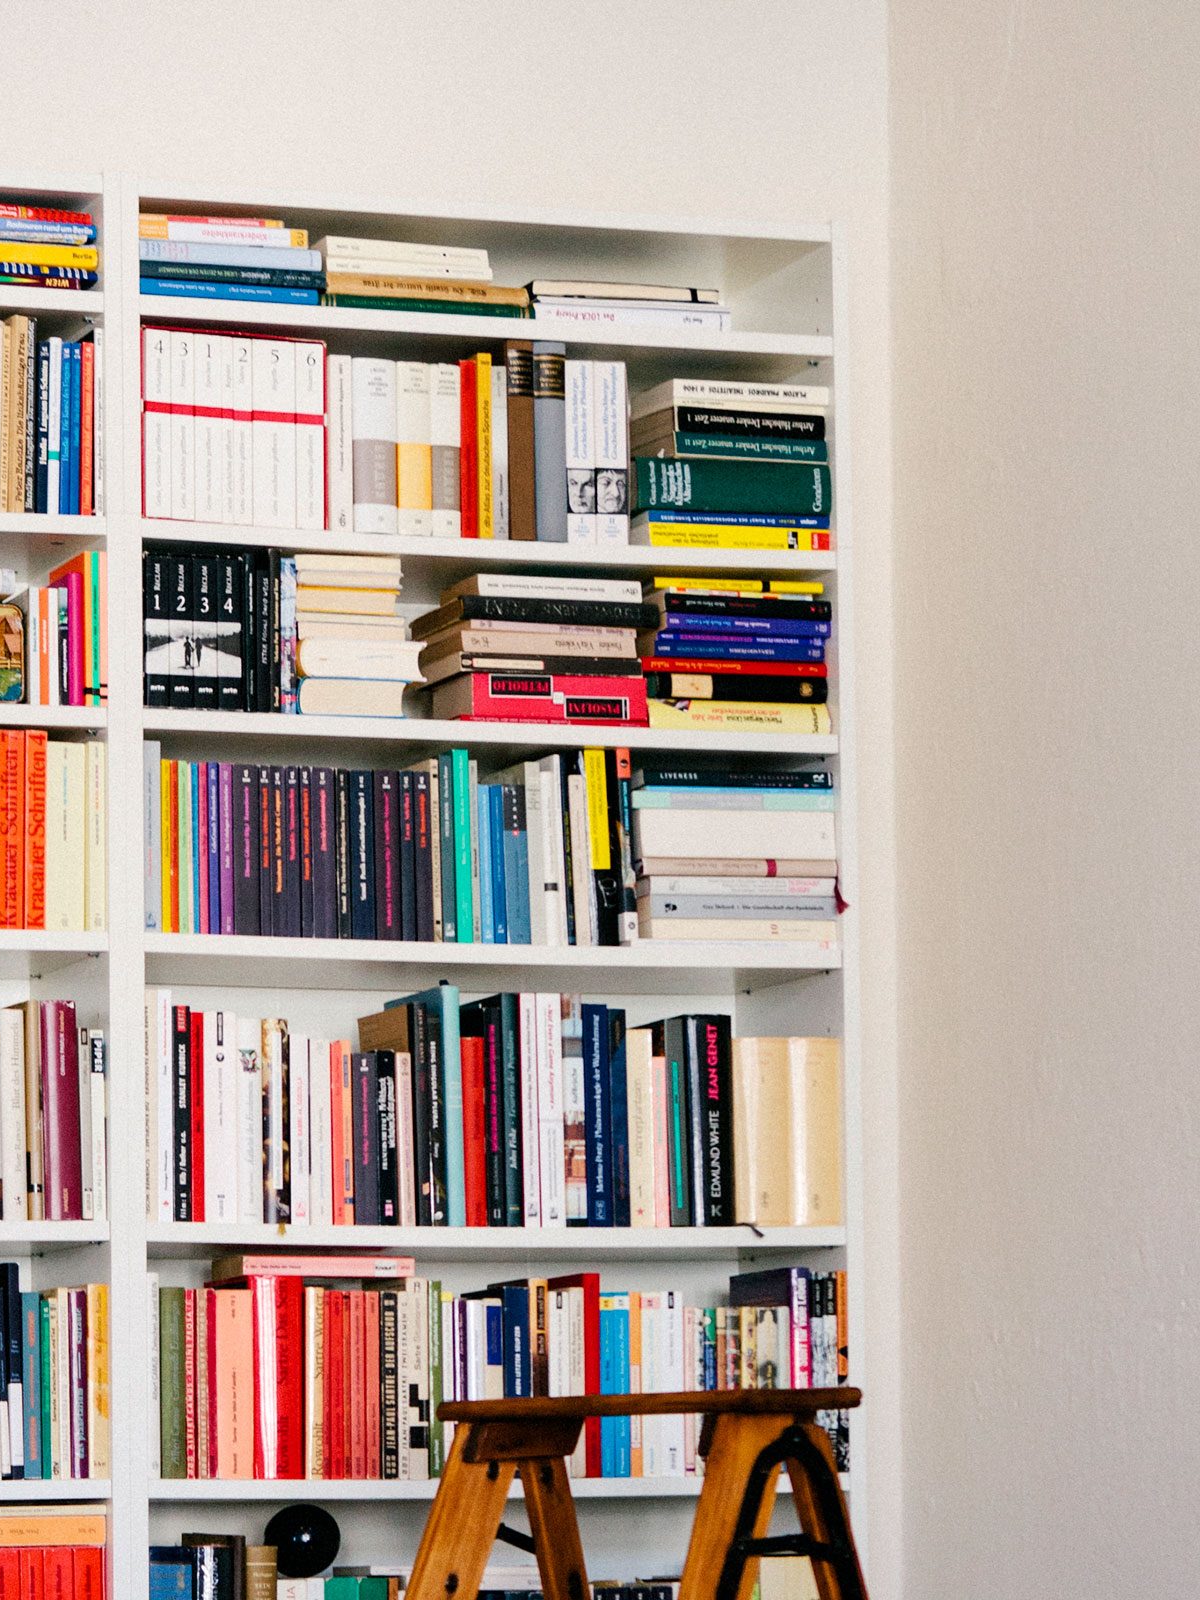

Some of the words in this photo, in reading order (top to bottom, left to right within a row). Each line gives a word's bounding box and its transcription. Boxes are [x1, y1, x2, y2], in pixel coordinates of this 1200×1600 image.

[47, 279, 70, 288] WIEN
[154, 340, 163, 354] 4
[180, 342, 188, 356] 3
[238, 348, 248, 362] 2
[270, 349, 280, 363] 5
[306, 352, 316, 366] 6
[695, 414, 709, 424] Zeit
[736, 418, 760, 428] Denker
[792, 422, 814, 432] Arthur
[692, 440, 707, 449] Zeit
[736, 442, 760, 452] Denker
[792, 446, 815, 455] Arthur
[812, 468, 822, 512] Gondrom
[176, 596, 186, 611] 2
[200, 597, 209, 613] 3
[223, 598, 233, 614] 4
[493, 681, 549, 692] PETROLIO
[569, 702, 620, 715] PASOLINI
[28, 734, 45, 745] 4
[0, 749, 17, 836] Schriften
[27, 751, 45, 837] Schriften
[0, 843, 17, 926] Kracauer
[27, 842, 45, 928] Kracauer
[706, 1025, 718, 1067] GENET
[94, 1040, 102, 1074] PIPER
[707, 1069, 719, 1101] JEAN
[708, 1111, 720, 1148] WHITE
[509, 1150, 517, 1169] John
[710, 1148, 721, 1199] EDMUND
[276, 1280, 286, 1310] Sein
[276, 1315, 287, 1339] Das
[384, 1311, 394, 1351] AUFSCHUB
[278, 1346, 288, 1385] Sartre
[313, 1340, 324, 1380] Sartre
[384, 1354, 394, 1368] DER
[385, 1375, 394, 1405] SARTRE
[385, 1408, 395, 1449] JEAN-PAUL
[277, 1415, 289, 1474] Rowohlt
[311, 1422, 323, 1476] Rowohlt
